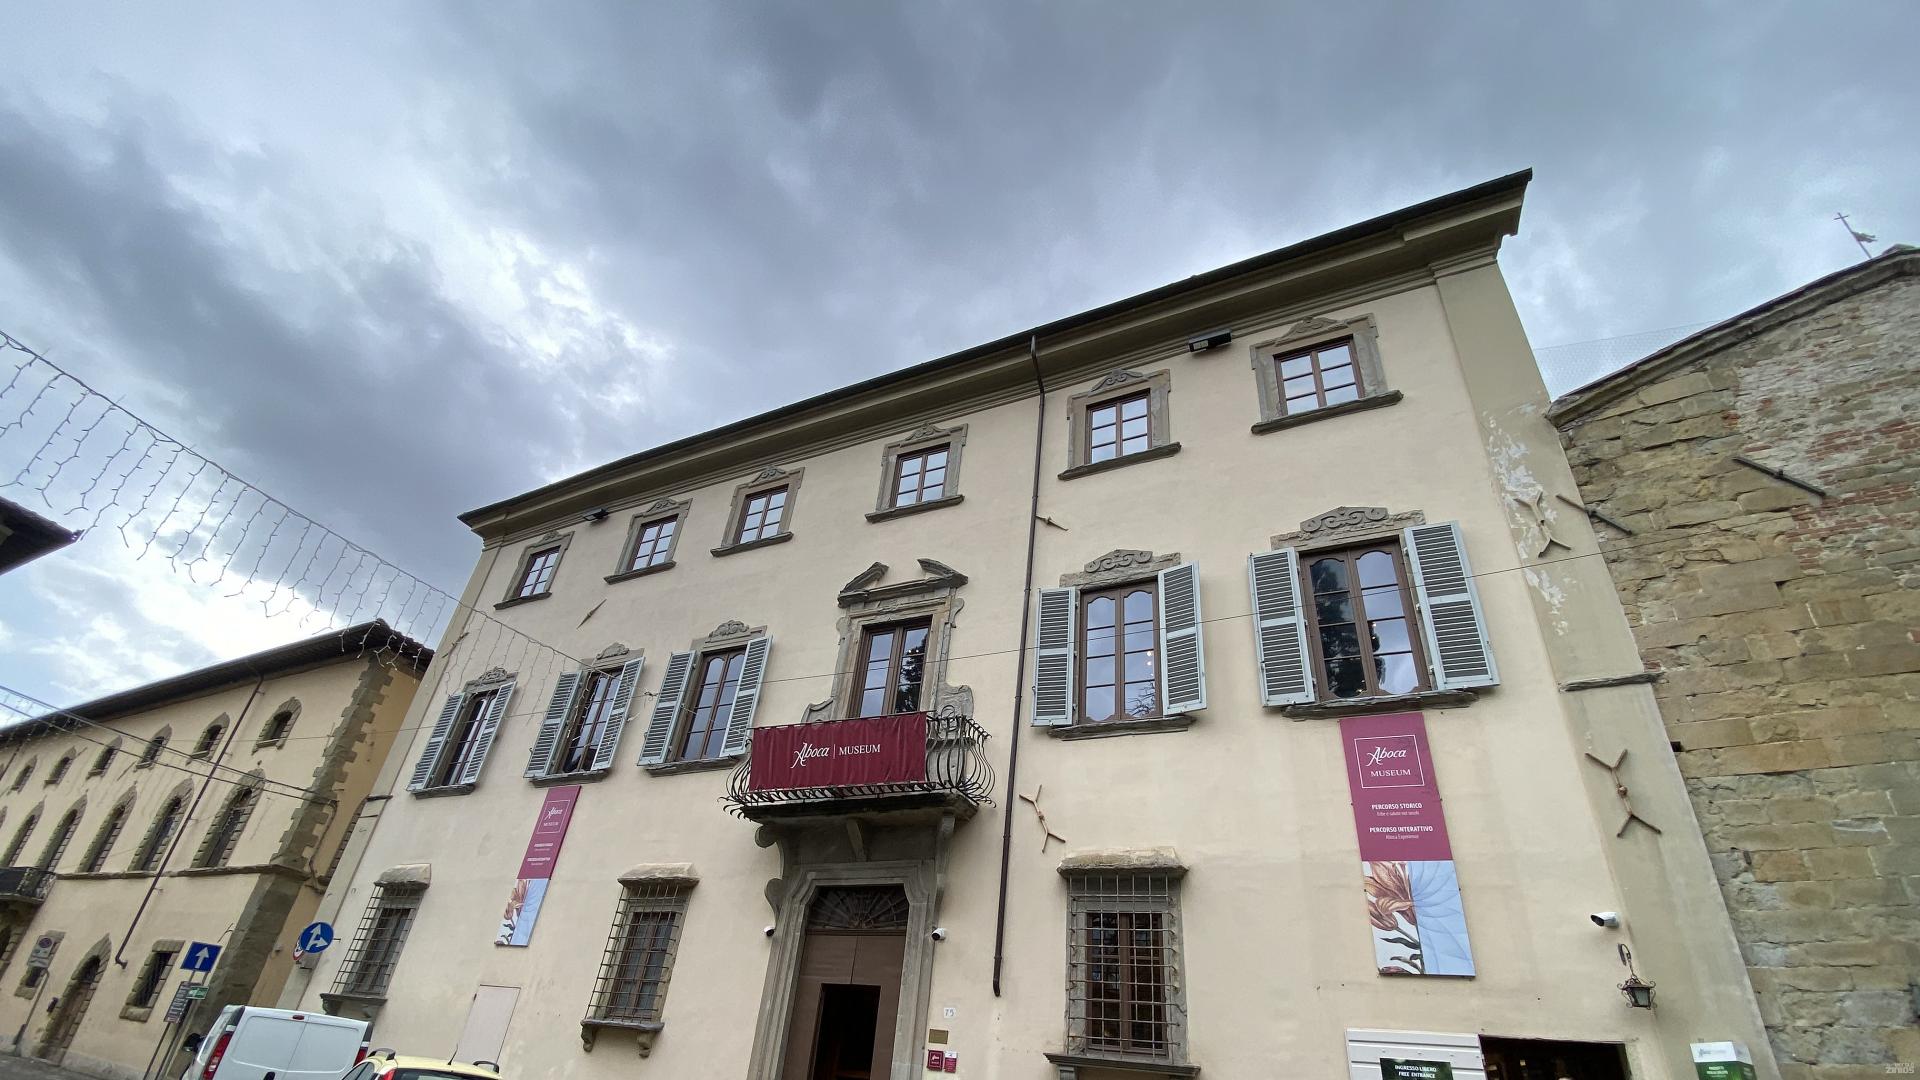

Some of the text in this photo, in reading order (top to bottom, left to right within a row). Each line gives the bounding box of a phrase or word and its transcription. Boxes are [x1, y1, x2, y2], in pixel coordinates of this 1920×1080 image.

[790, 742, 881, 768] Aboca MUSEUM
[1366, 747, 1407, 766] Aboca
[1371, 769, 1411, 777] MUSEUM
